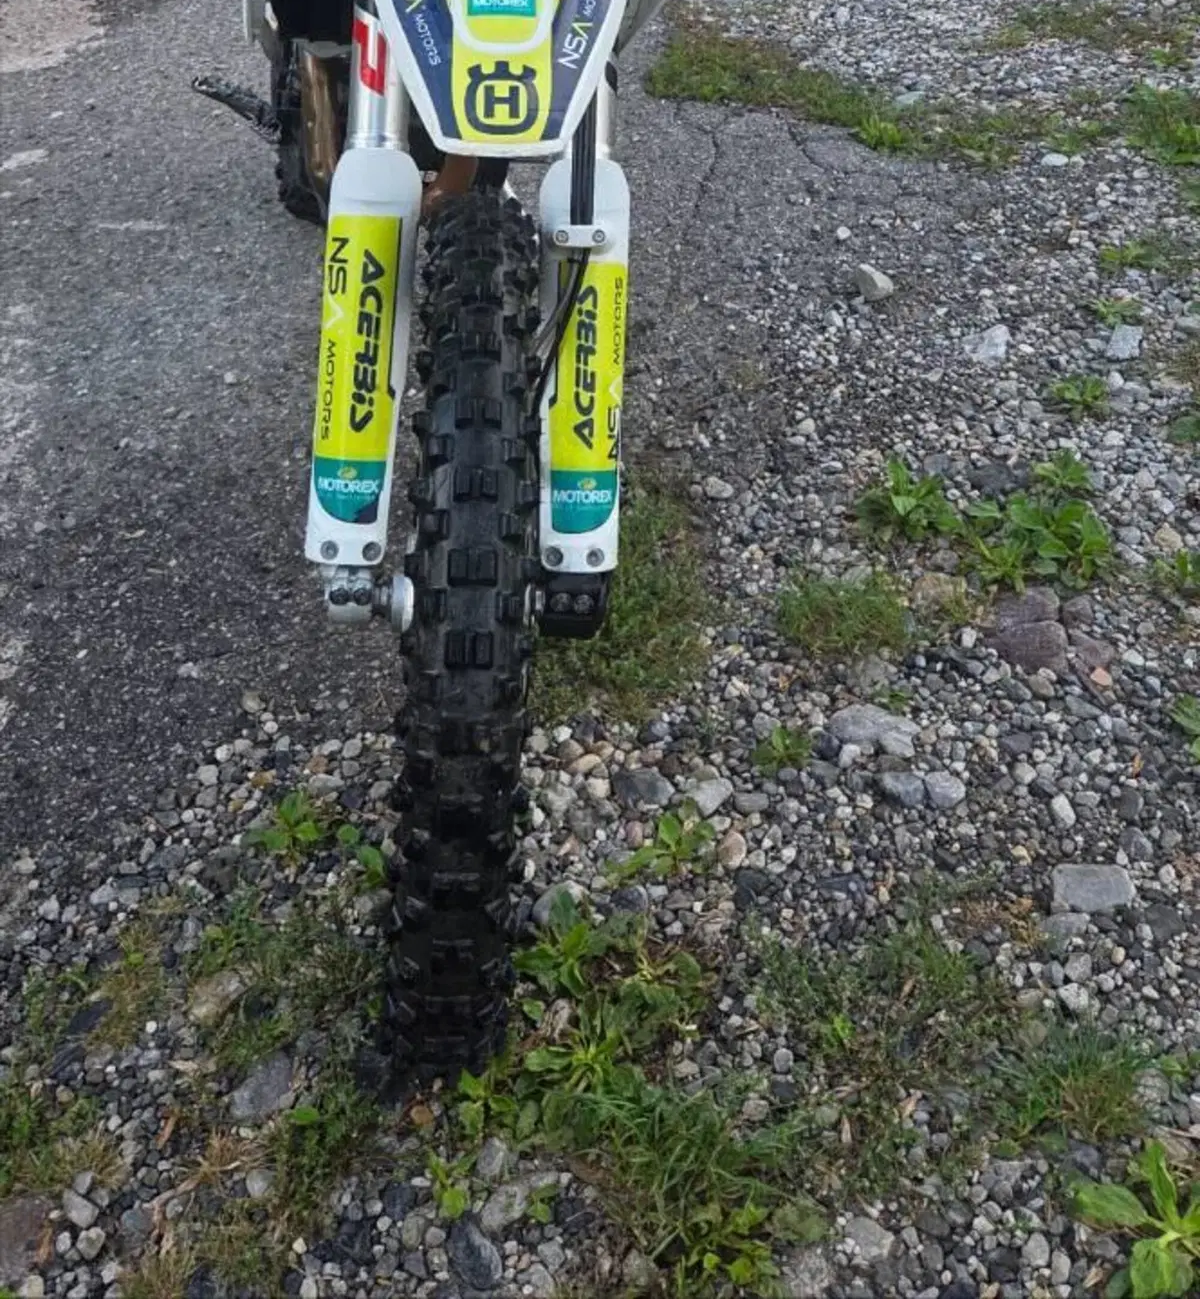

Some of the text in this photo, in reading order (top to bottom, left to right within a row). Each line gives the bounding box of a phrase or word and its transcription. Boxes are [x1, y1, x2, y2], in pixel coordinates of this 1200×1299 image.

[414, 13, 442, 66] MOTORS
[558, 21, 593, 69] NSA
[613, 276, 624, 365] MOTORS
[320, 339, 337, 441] MOTORS
[318, 476, 379, 493] MOTOREX
[553, 489, 613, 504] MOTOREX
